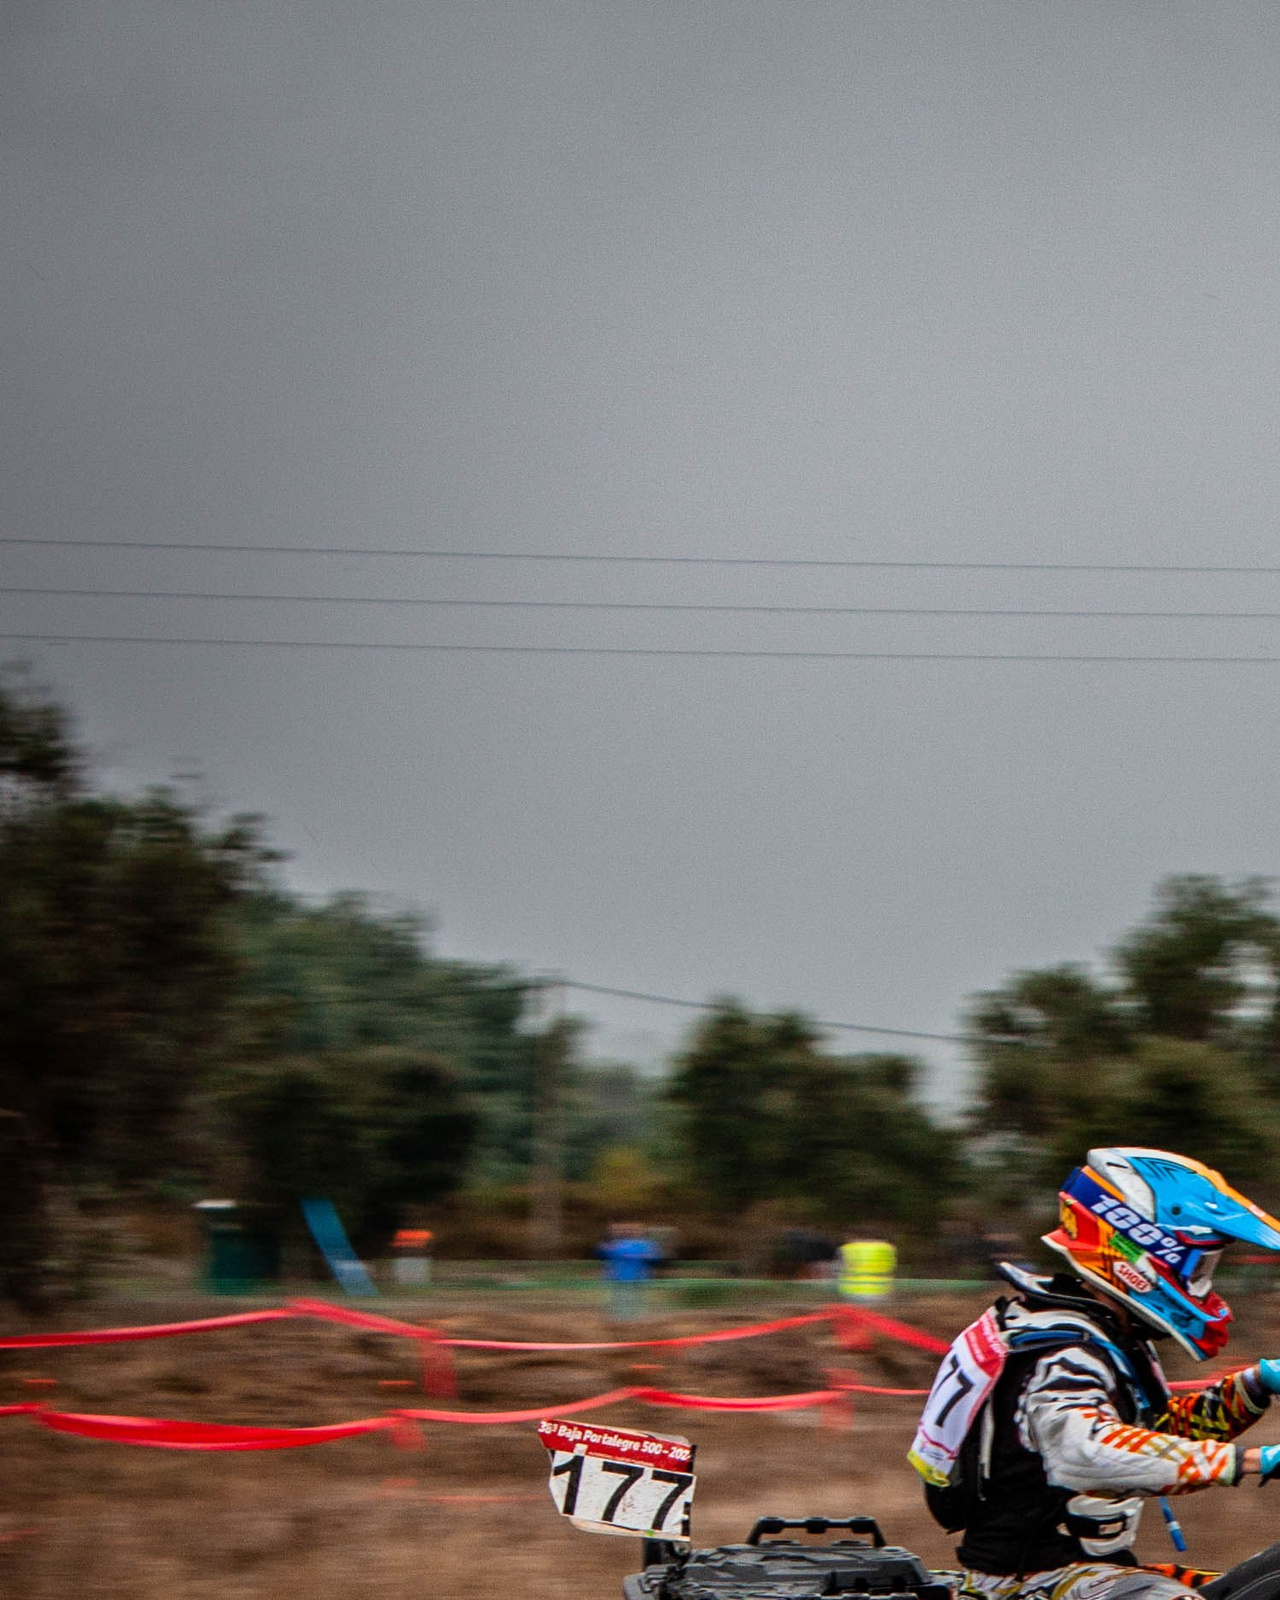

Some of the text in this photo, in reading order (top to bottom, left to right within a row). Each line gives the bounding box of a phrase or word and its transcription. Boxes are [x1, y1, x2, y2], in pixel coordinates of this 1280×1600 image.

[1090, 1194, 1187, 1264] 100%
[1117, 1263, 1149, 1291] SHOEI
[558, 1425, 582, 1441] Baja
[583, 1429, 641, 1452] Portalegre
[642, 1440, 661, 1455] 500
[553, 1455, 693, 1531] 177
